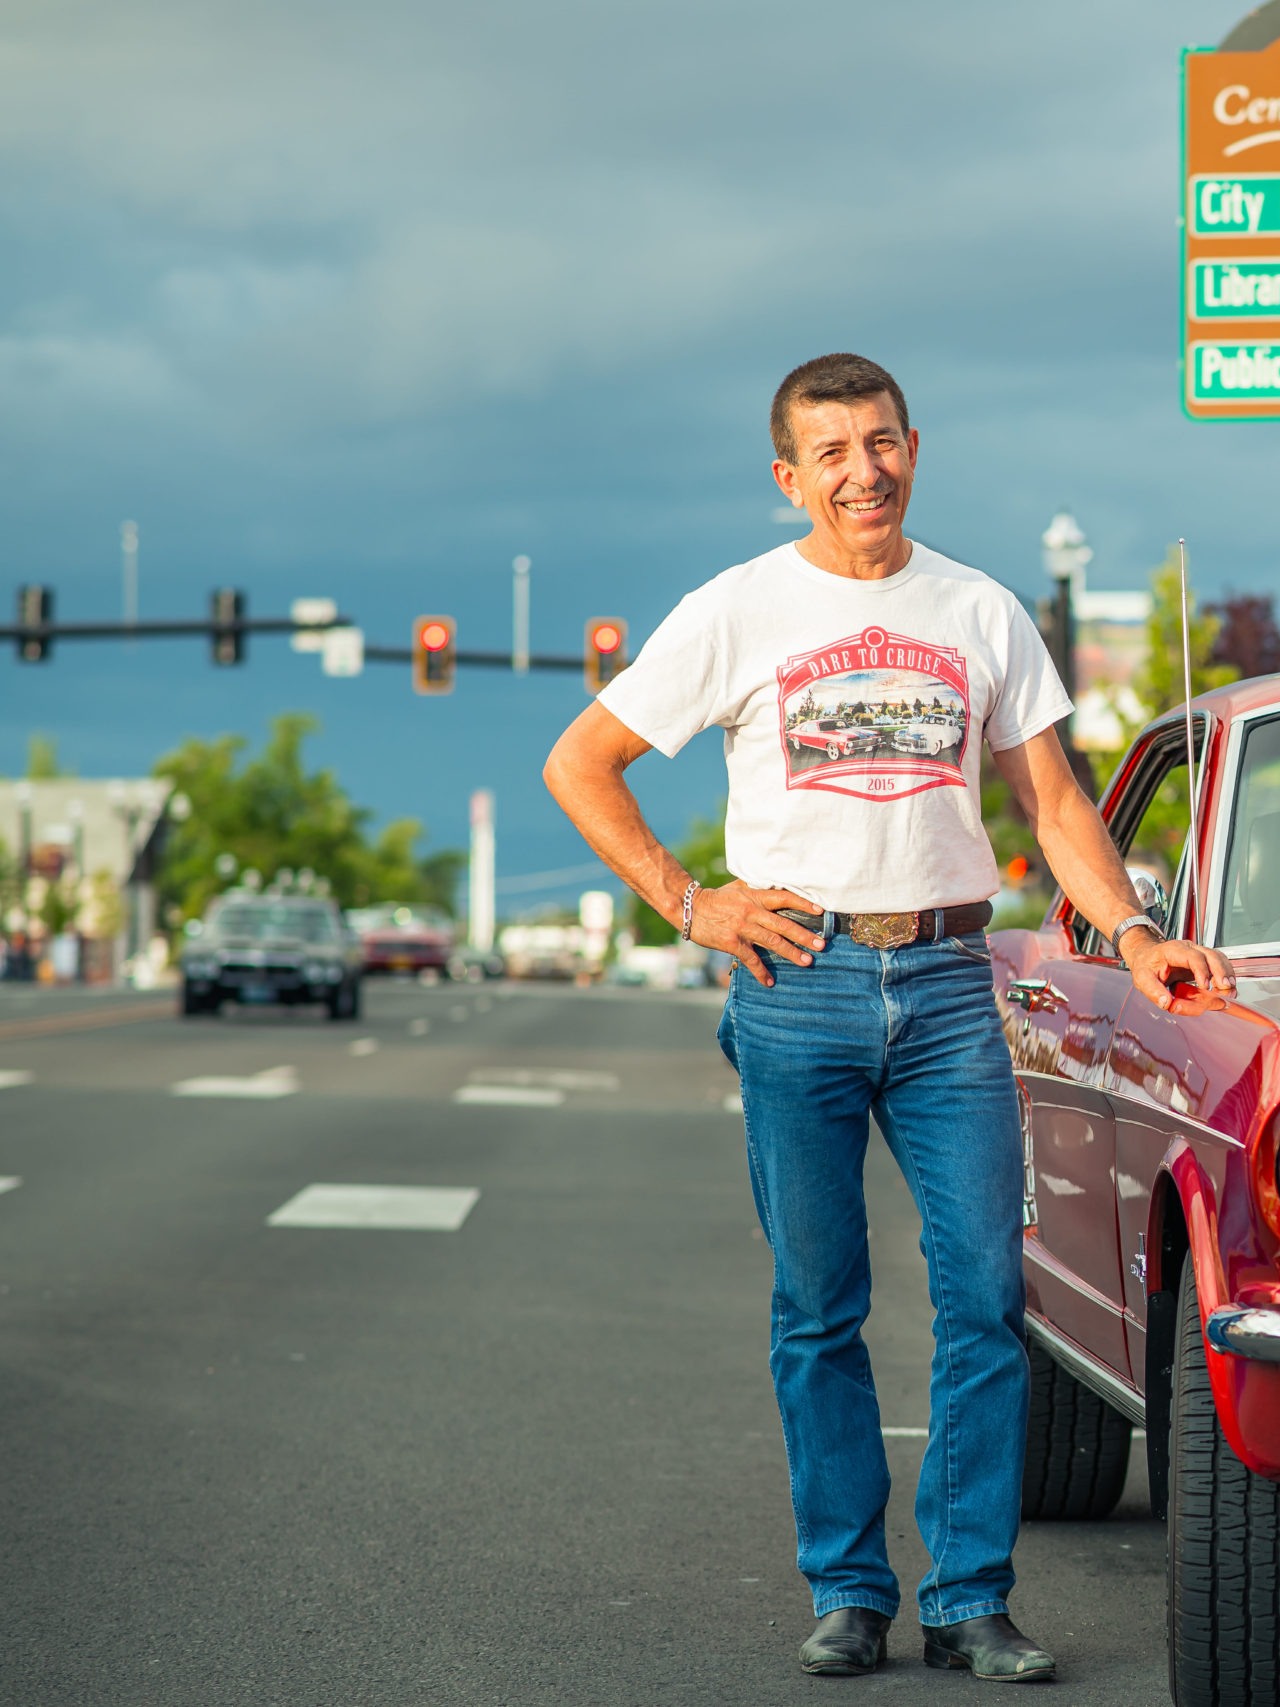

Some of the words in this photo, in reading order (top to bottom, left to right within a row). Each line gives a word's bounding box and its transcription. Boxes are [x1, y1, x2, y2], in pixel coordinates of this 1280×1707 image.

[1200, 181, 1265, 232] City
[807, 650, 852, 678] DARE
[858, 648, 878, 667] TO
[886, 647, 942, 675] CRUISE
[867, 778, 895, 791] 2015
